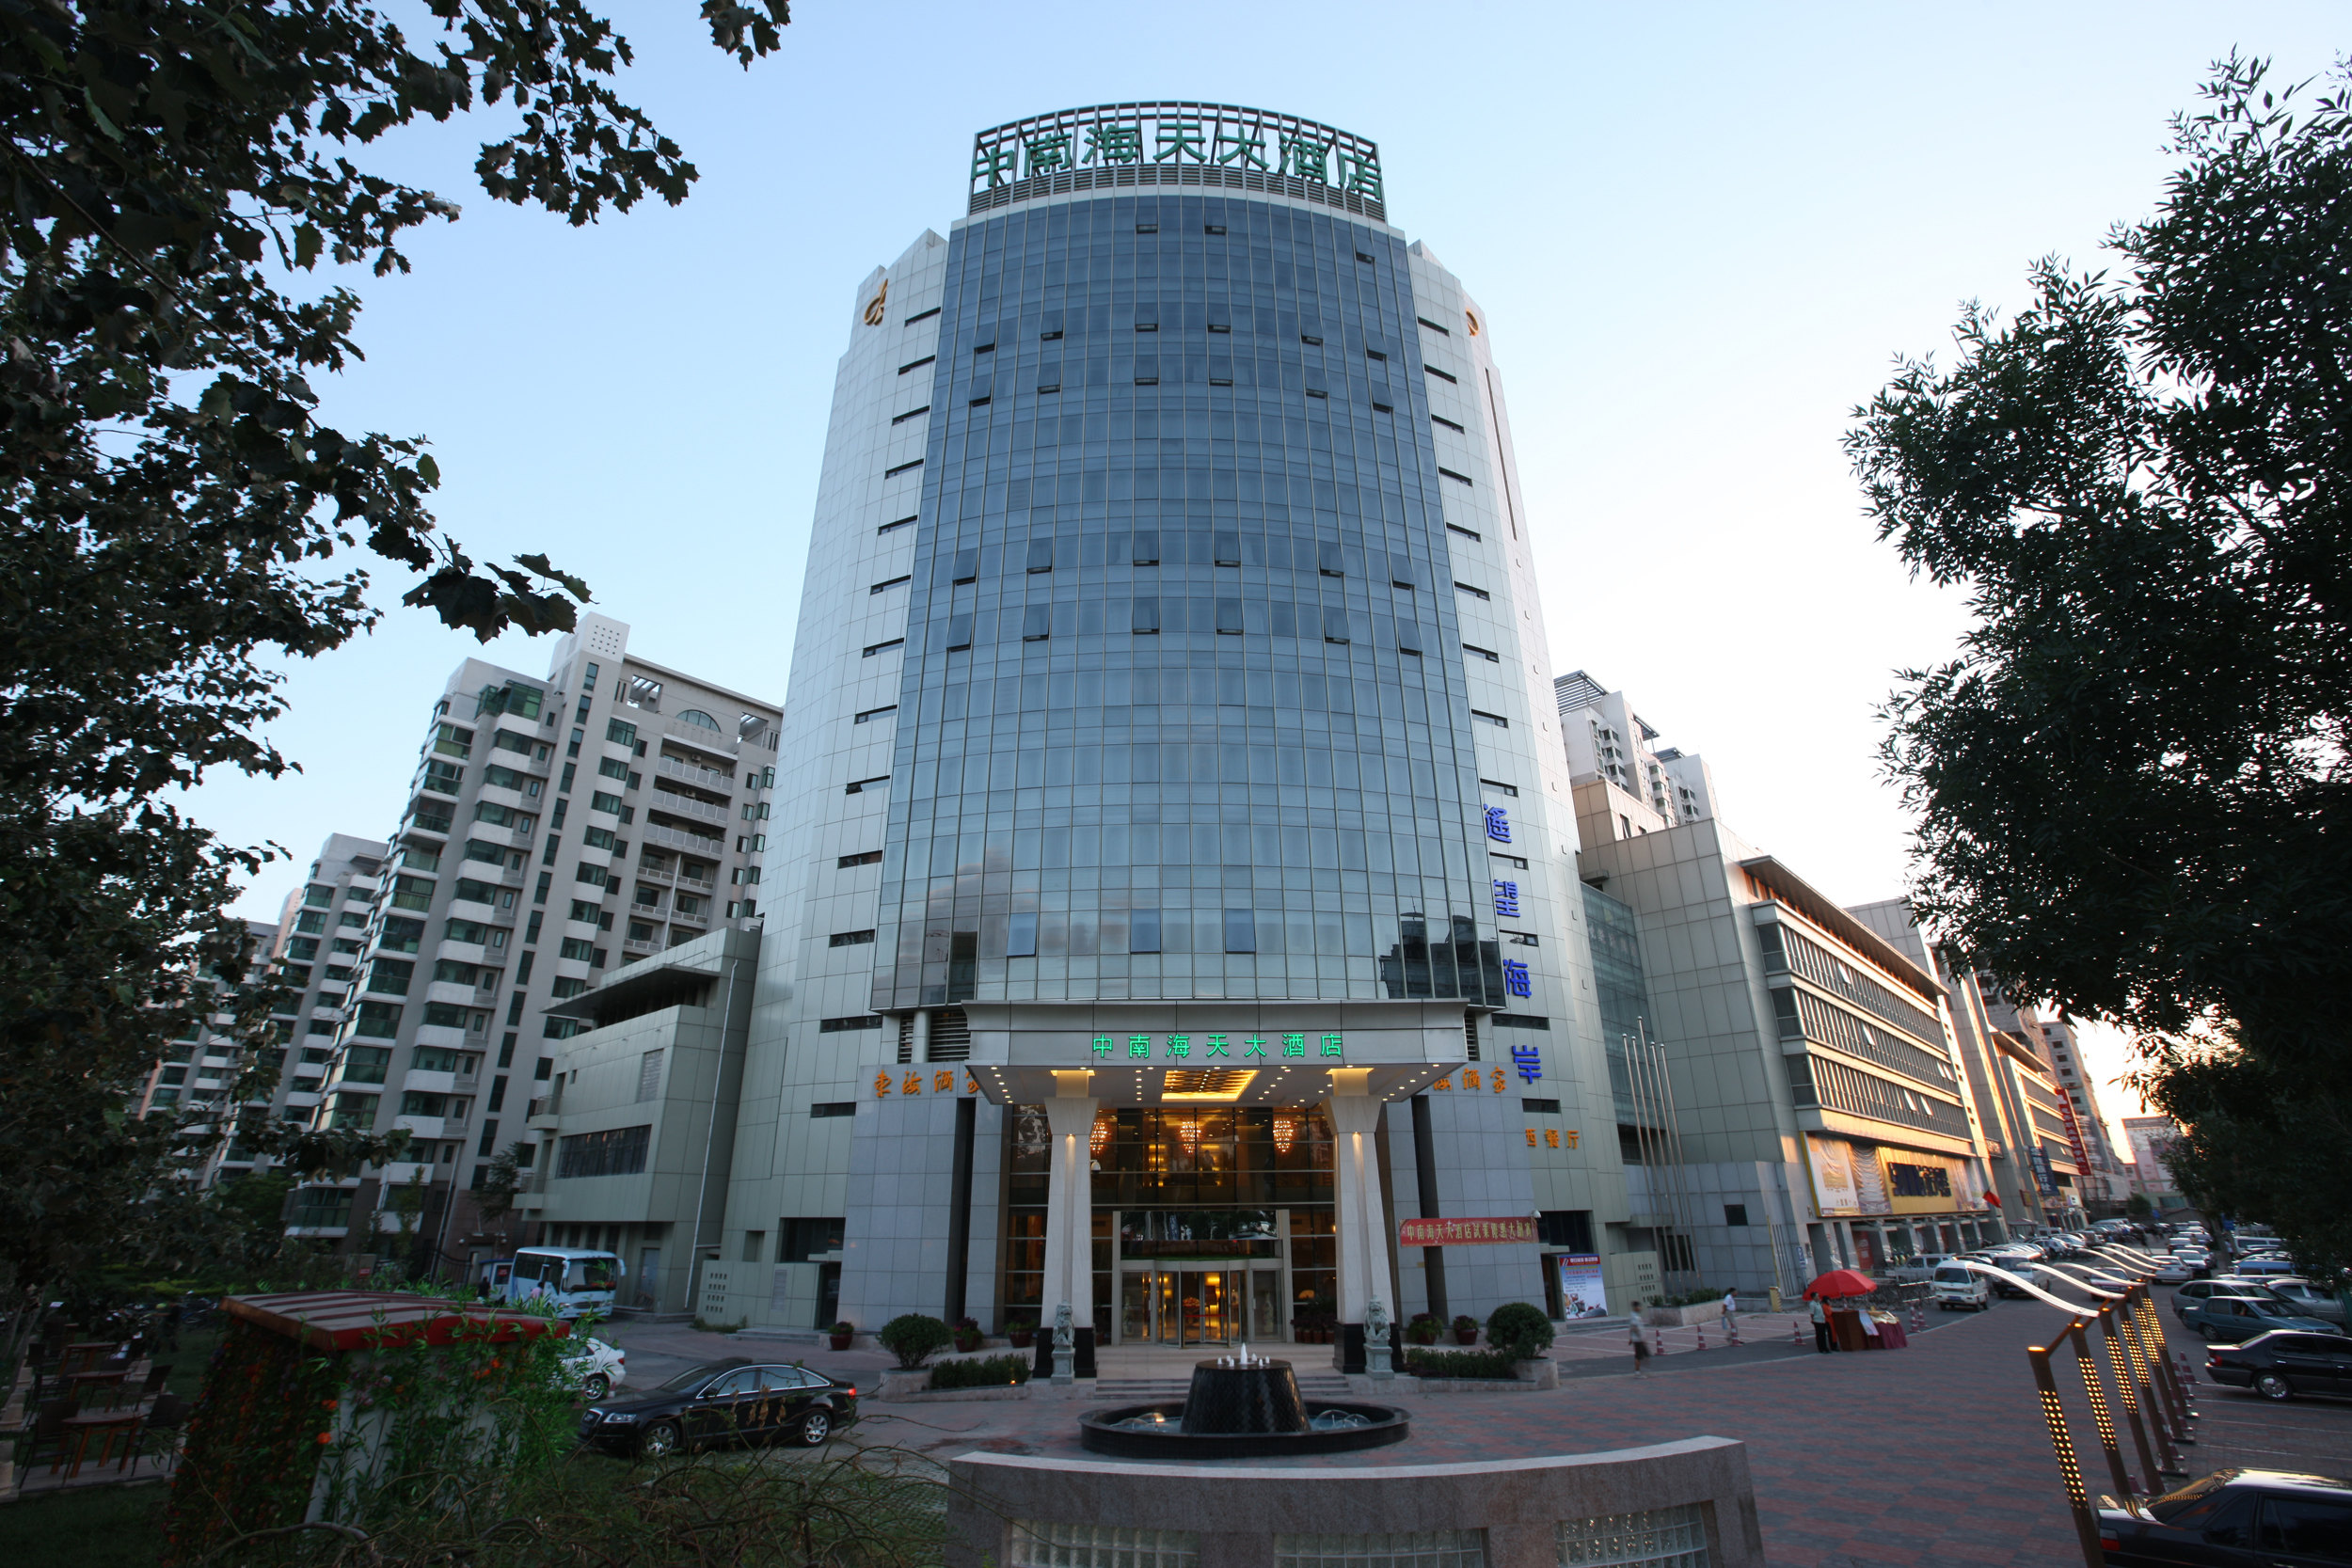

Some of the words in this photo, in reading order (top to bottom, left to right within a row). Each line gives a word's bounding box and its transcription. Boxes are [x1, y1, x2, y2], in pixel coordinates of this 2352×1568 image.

[972, 123, 1382, 200] 中南海天大酒店
[1092, 1033, 1343, 1059] 中南海天大酒店
[1525, 1128, 1580, 1149] 西餐厅
